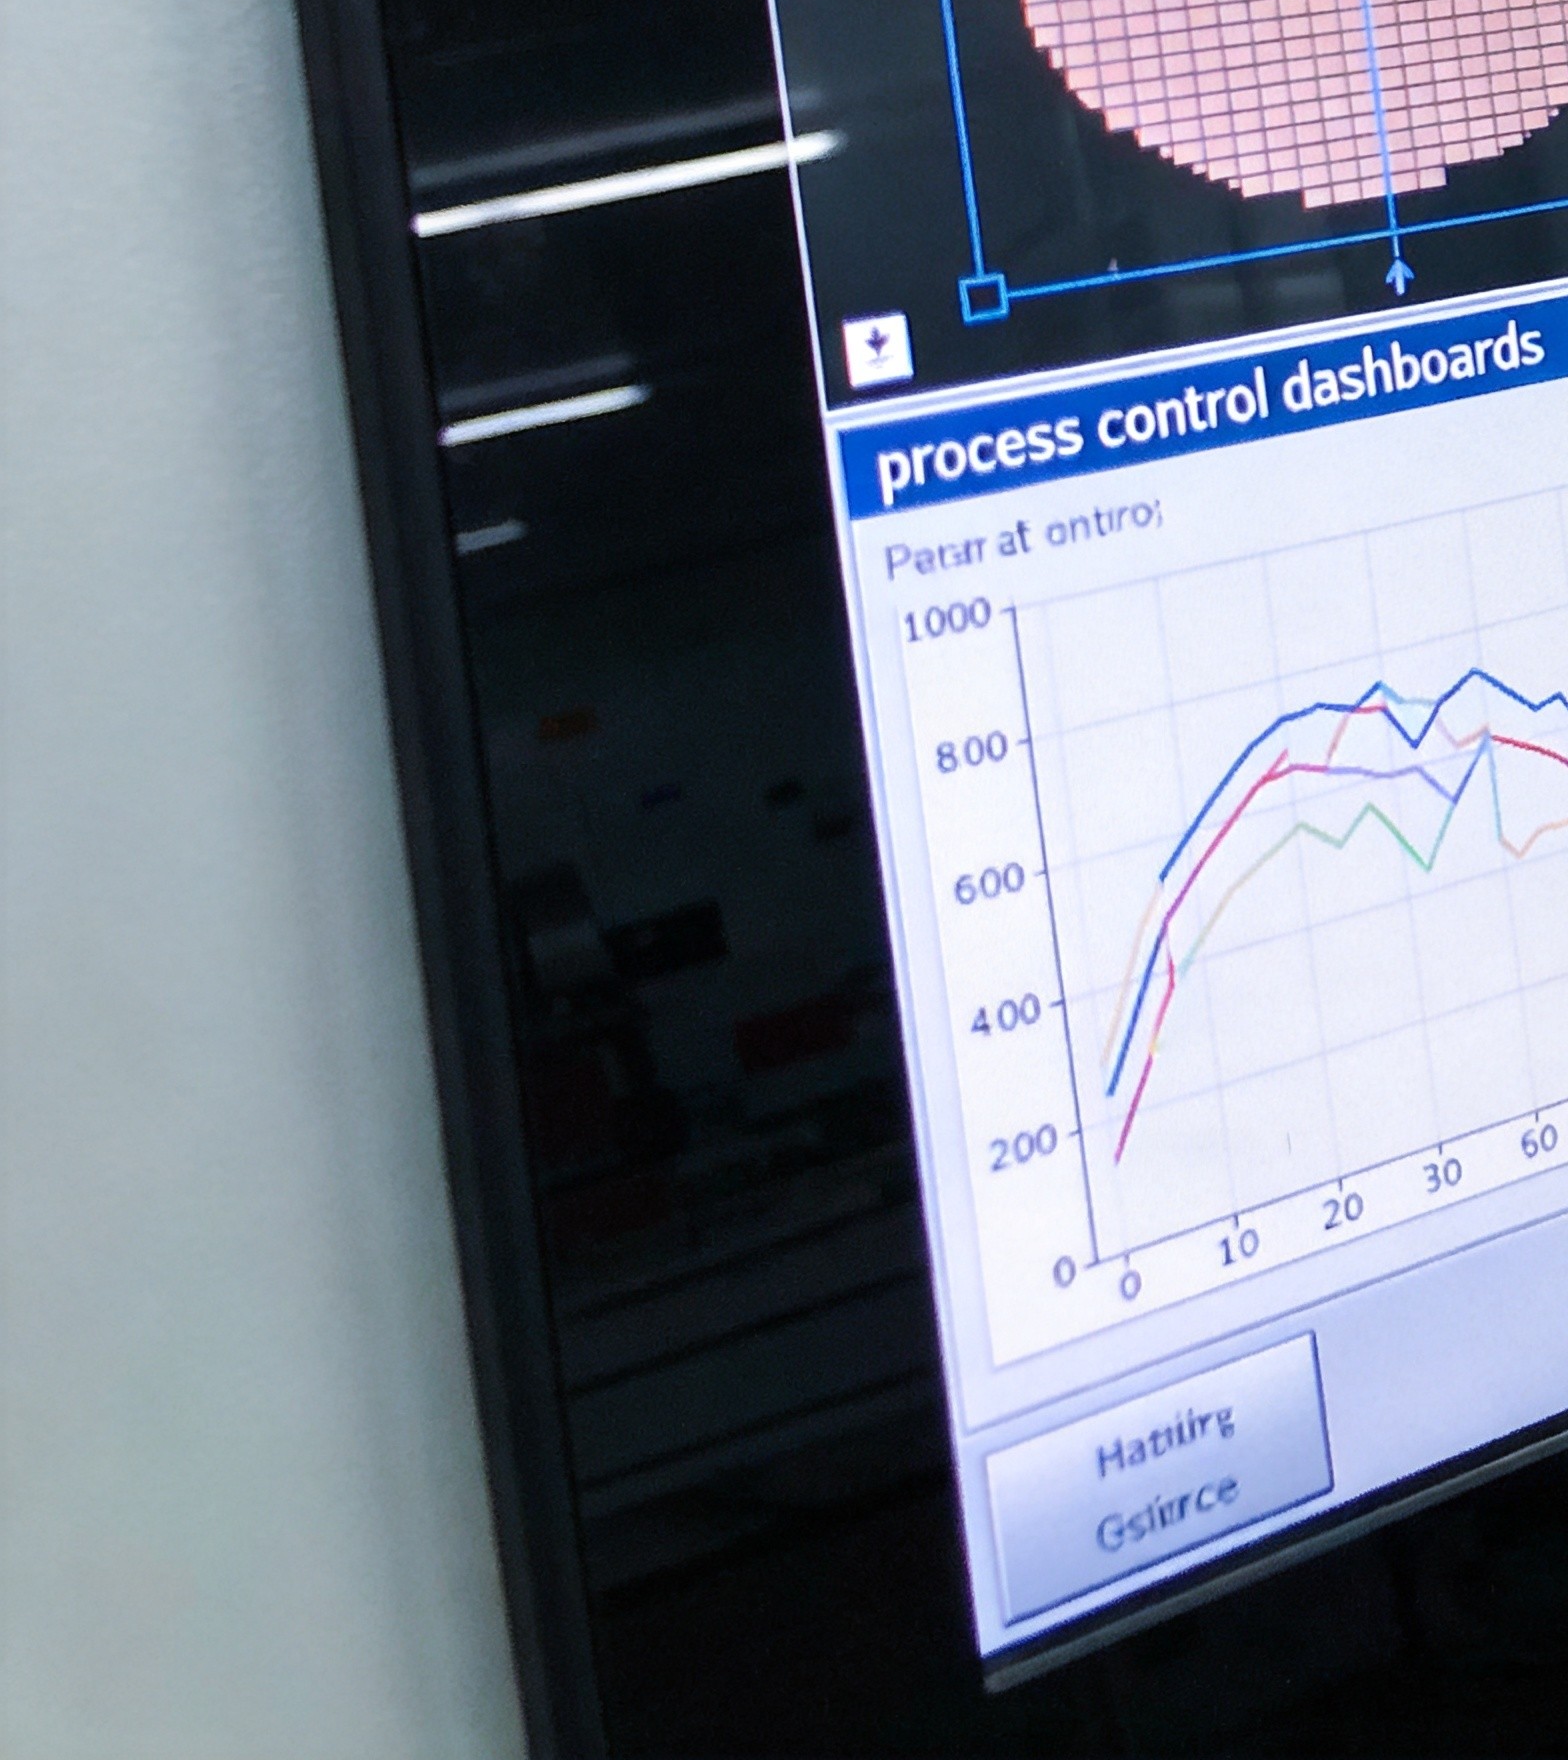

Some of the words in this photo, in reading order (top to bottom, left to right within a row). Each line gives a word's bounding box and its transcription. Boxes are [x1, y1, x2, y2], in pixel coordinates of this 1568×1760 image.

[878, 414, 1083, 505] process
[1097, 365, 1270, 448] control
[1282, 318, 1545, 413] dashboards
[902, 596, 992, 642] 1000
[935, 730, 1008, 774] 800
[954, 861, 1026, 905] 600
[971, 992, 1041, 1036] 400
[988, 1123, 1058, 1173] 200
[1119, 1268, 1142, 1301] 0
[1220, 1227, 1261, 1266] 10
[1323, 1193, 1365, 1230] 20
[1423, 1157, 1463, 1194] 30
[1520, 1123, 1559, 1160] 60
[1052, 1255, 1077, 1288] 0
